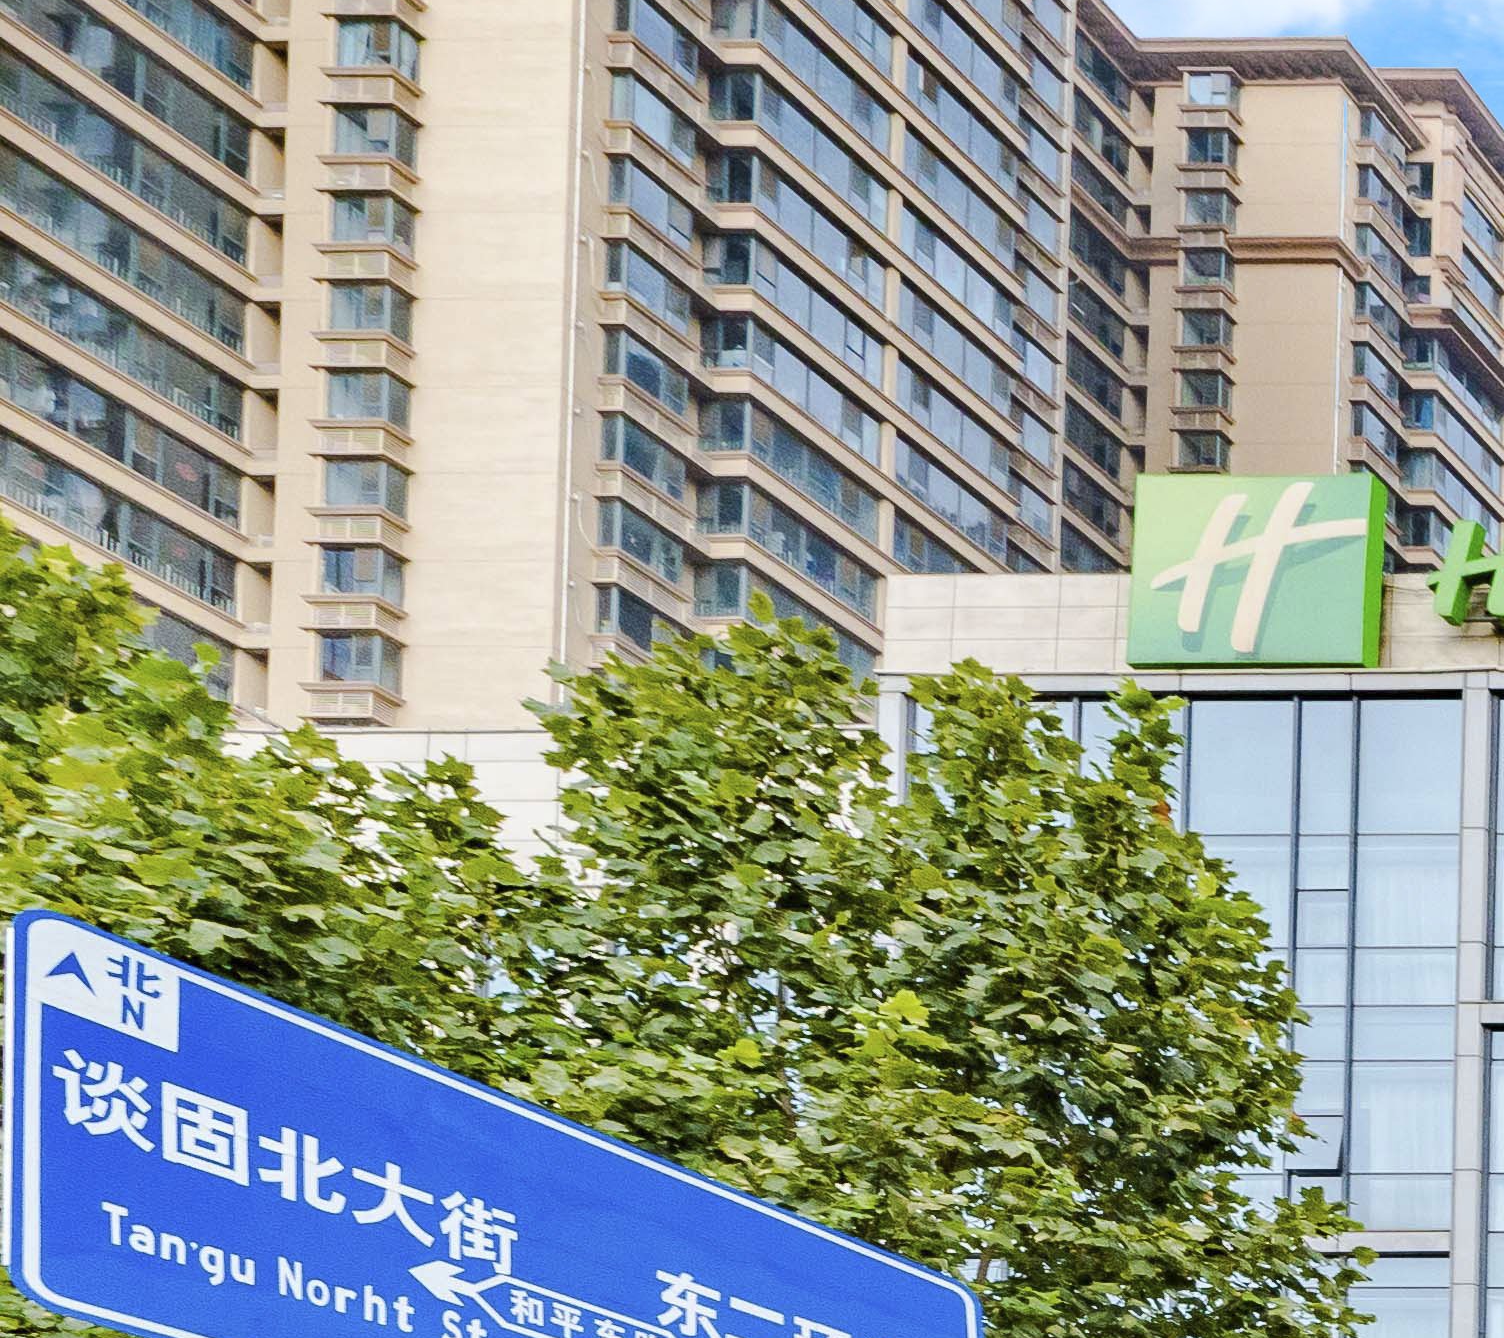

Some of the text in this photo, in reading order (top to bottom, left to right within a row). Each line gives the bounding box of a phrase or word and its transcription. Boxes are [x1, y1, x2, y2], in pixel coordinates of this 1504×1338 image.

[106, 954, 163, 999] 北
[121, 994, 145, 1031] N
[52, 1047, 519, 1275] 谈固北大街
[277, 1256, 416, 1334] Norht
